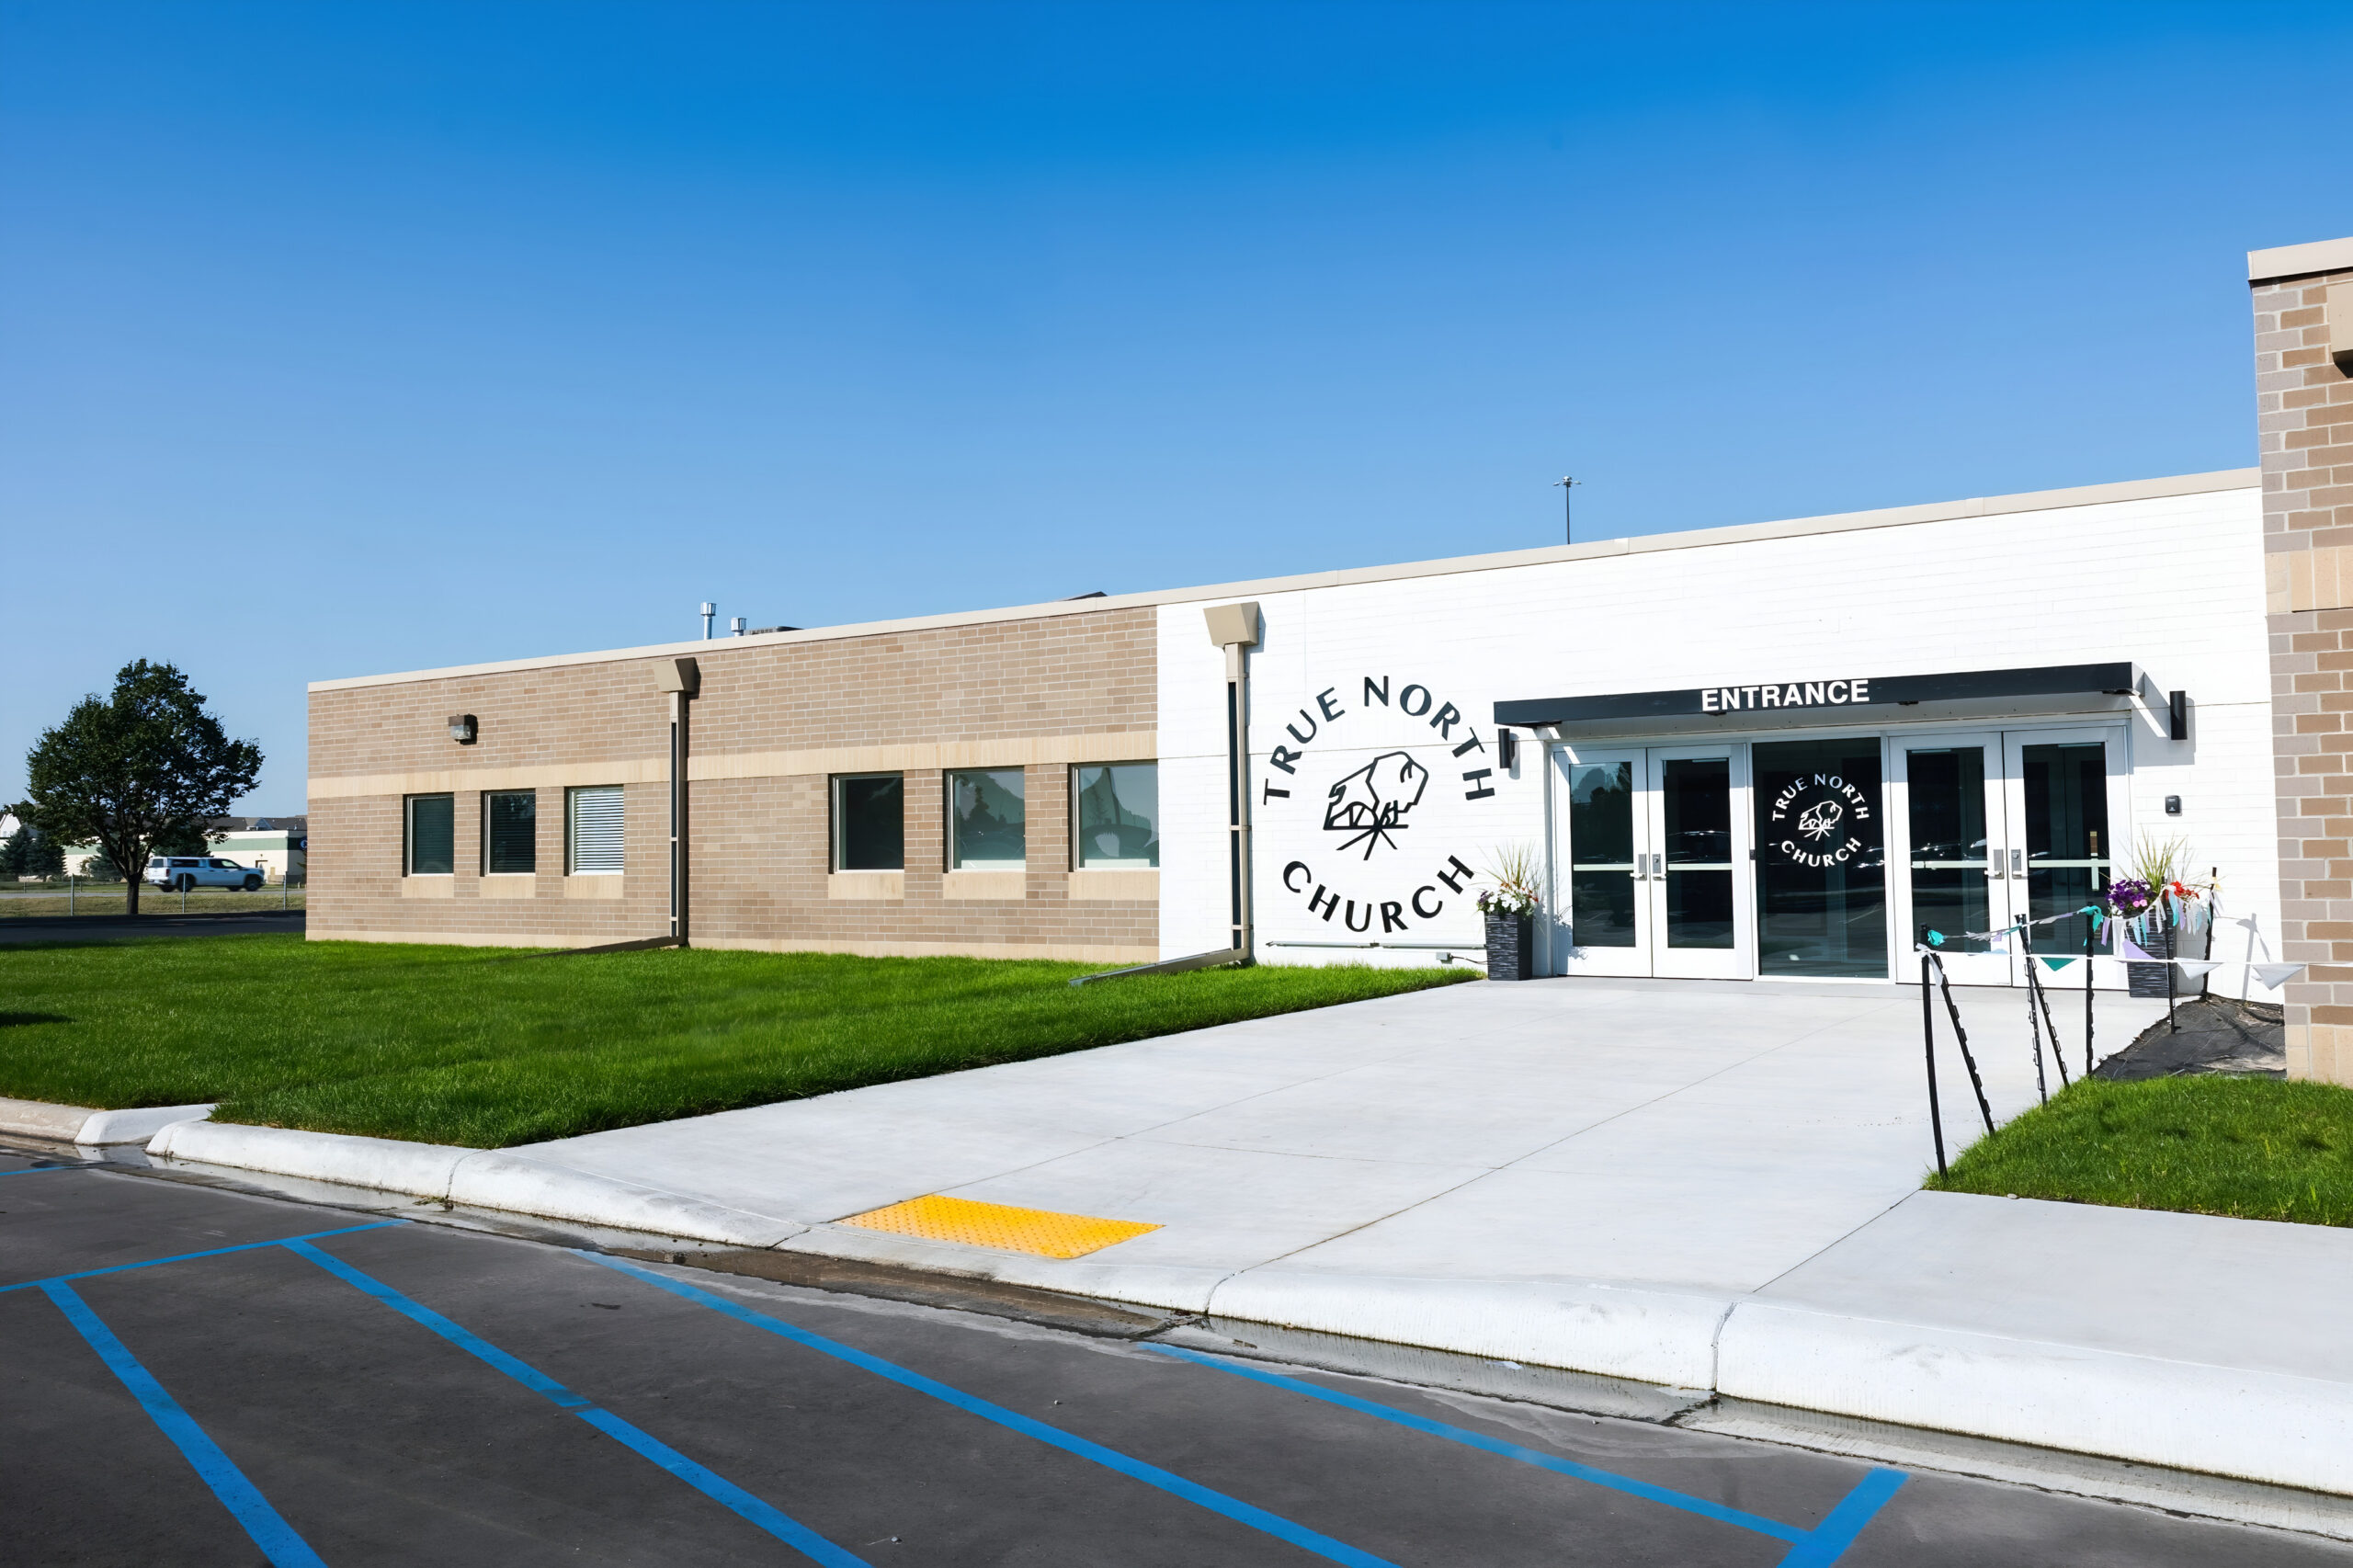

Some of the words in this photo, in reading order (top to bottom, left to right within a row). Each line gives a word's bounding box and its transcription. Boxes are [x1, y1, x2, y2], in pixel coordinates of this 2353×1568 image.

[1701, 679, 1870, 711] ENTRANCE
[1263, 687, 1346, 806] TRUE
[1364, 676, 1495, 801] NORTH
[1772, 778, 1808, 821] TRUE
[1814, 773, 1870, 819] NORTH
[1781, 837, 1861, 867] CHURCH
[1283, 855, 1474, 933] CHURCH
